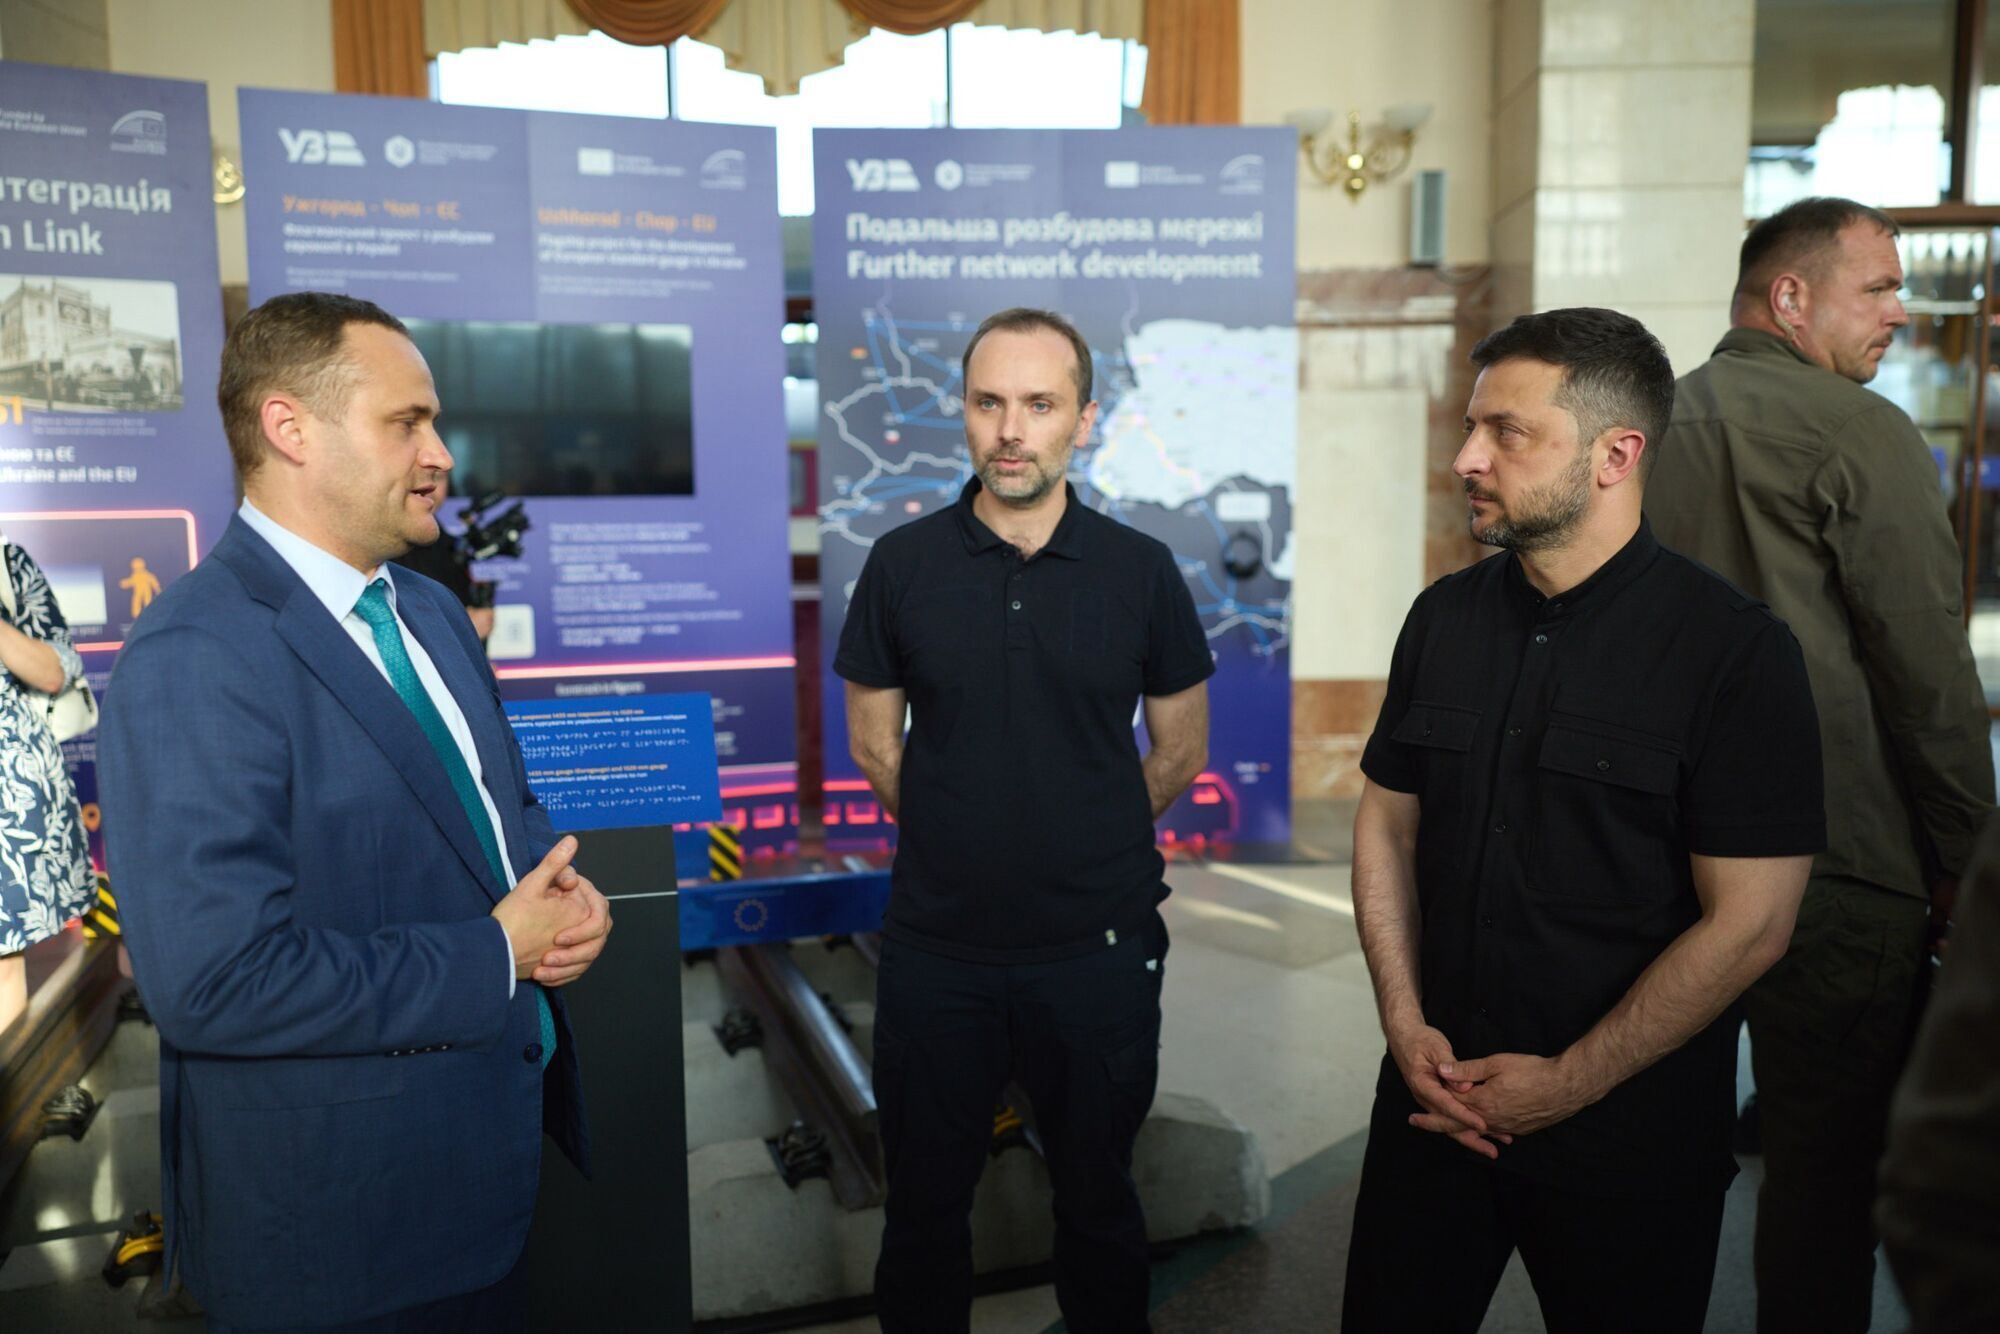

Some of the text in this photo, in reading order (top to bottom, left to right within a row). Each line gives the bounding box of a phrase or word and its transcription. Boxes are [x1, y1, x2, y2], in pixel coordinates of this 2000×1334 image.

[0, 176, 172, 215] теграція
[23, 219, 104, 255] Link
[846, 211, 1263, 248] Подальша розбудова мережі
[847, 248, 1262, 285] Further network development
